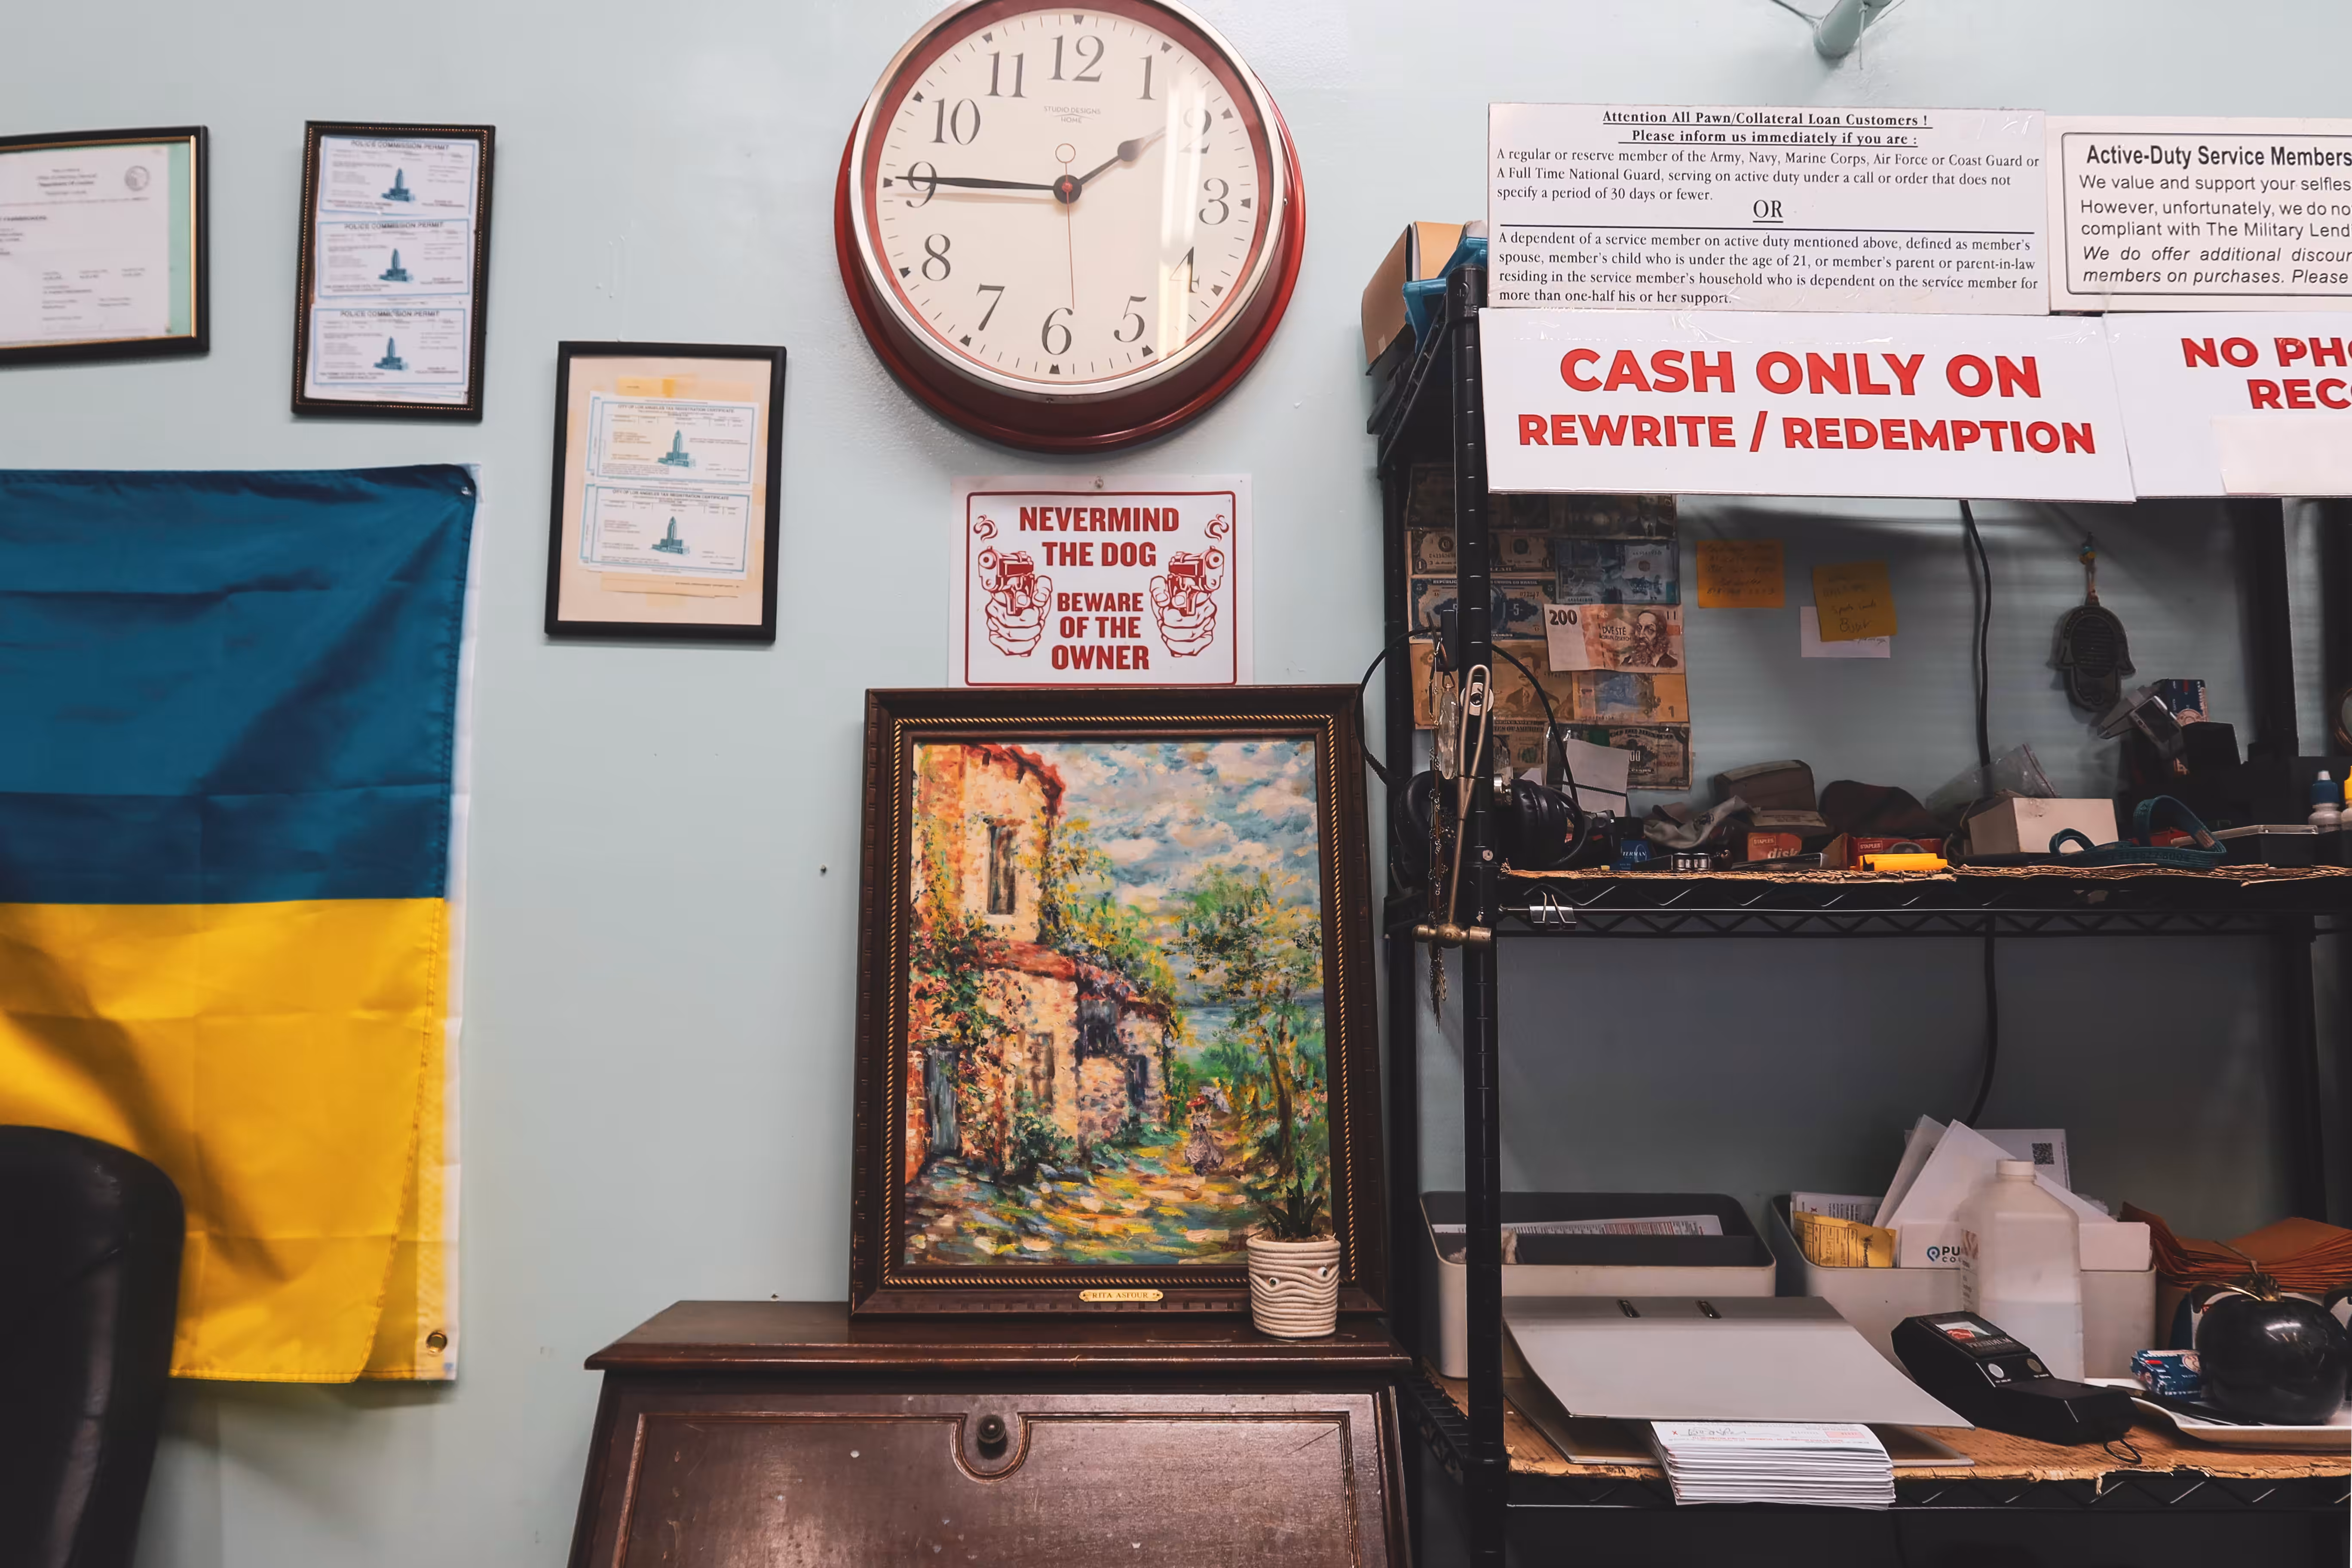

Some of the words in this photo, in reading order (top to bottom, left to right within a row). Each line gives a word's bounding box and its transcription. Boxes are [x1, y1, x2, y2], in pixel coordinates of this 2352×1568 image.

[1048, 35, 1104, 82] 12
[985, 52, 1028, 98] 11
[1136, 54, 1156, 101] 1
[930, 98, 981, 145] 10
[1602, 110, 1667, 123] Attention
[1671, 110, 1690, 123] All
[1695, 111, 1804, 124] Pawn/Collateral
[1808, 113, 1841, 125] Loan
[1846, 113, 1918, 126] Customers
[1179, 107, 1212, 155] 2
[1632, 129, 1675, 142] Please
[1680, 129, 1727, 142] inform
[1731, 134, 1747, 143] us
[1751, 131, 1838, 144] immediately
[1842, 132, 1853, 144] if
[1856, 135, 1881, 144] you
[1886, 135, 1908, 145] are
[1497, 148, 1505, 159] A
[1509, 148, 1551, 163] regular
[1555, 152, 1568, 160] or
[1571, 152, 1614, 161] reserve
[1618, 149, 1668, 162] member
[1671, 150, 1685, 162] of
[1687, 150, 1706, 162] the
[1710, 151, 1744, 166] Army,
[1749, 151, 1781, 166] Navy,
[1785, 152, 1826, 164] Marine
[1830, 152, 1870, 168] Corps,
[1873, 153, 1891, 165] Air
[1895, 153, 1928, 165] Force
[1931, 157, 1945, 165] or
[1949, 154, 1982, 166] Coast
[1985, 154, 2022, 167] Guard
[2026, 158, 2040, 167] or
[2086, 144, 2192, 169] Active-Duty
[2197, 145, 2265, 166] Service
[906, 161, 938, 208] 9
[1497, 185, 1538, 201] specify
[1541, 189, 1548, 198] a
[1552, 186, 1591, 202] period
[1595, 187, 1608, 199] of
[1611, 187, 1626, 200] 30
[1629, 187, 1656, 203] days
[1659, 191, 1673, 200] or
[1676, 187, 1713, 200] fewer.
[2079, 174, 2106, 189] We
[2111, 175, 2155, 190] value
[2159, 175, 2190, 190] and
[2195, 176, 2256, 194] support
[2260, 179, 2297, 194] your
[1198, 177, 1229, 225] 3
[1753, 199, 1784, 218] OR
[2081, 199, 2158, 217] However,
[2162, 200, 2275, 219] unfortunately,
[2278, 204, 2303, 216] we
[2306, 201, 2327, 216] do
[2081, 221, 2162, 239] compliant
[2167, 221, 2200, 236] with
[2205, 222, 2238, 237] The
[2244, 222, 2304, 241] Military
[922, 233, 951, 281] 8
[2083, 245, 2110, 260] We
[2120, 246, 2141, 261] do
[2151, 246, 2191, 261] offer
[2199, 246, 2282, 262] additional
[2083, 267, 2162, 283] members
[2167, 271, 2187, 283] on
[2193, 268, 2285, 286] purchases.
[2291, 269, 2349, 284] Please
[976, 282, 1006, 331] 7
[1499, 291, 1530, 301] more
[1534, 288, 1561, 301] than
[1565, 289, 1616, 302] one-half
[1618, 290, 1635, 302] his
[1639, 294, 1653, 303] or
[1657, 290, 1678, 303] her
[1681, 292, 1732, 306] support.
[1041, 306, 1074, 355] 6
[1113, 295, 1147, 343] 5
[2181, 337, 2259, 368] NO
[2274, 337, 2352, 367] PH
[1561, 349, 1735, 393] CASH
[1756, 351, 1925, 396] ONLY
[1946, 354, 2041, 398] ON
[2247, 378, 2352, 410] REC
[1519, 414, 1736, 447] REWRITE
[1782, 417, 2096, 454] REDEMPTION
[1020, 507, 1179, 532] NEVERMIND
[1042, 541, 1094, 567] THE
[1101, 541, 1157, 567] DOG
[1057, 592, 1144, 612] BEWARE
[1513, 603, 1520, 616] 5
[1060, 616, 1090, 638] OF
[1095, 616, 1141, 638] THE
[1549, 609, 1577, 625] 200
[1051, 644, 1150, 670] OWNER
[1942, 1246, 1960, 1256] PU
